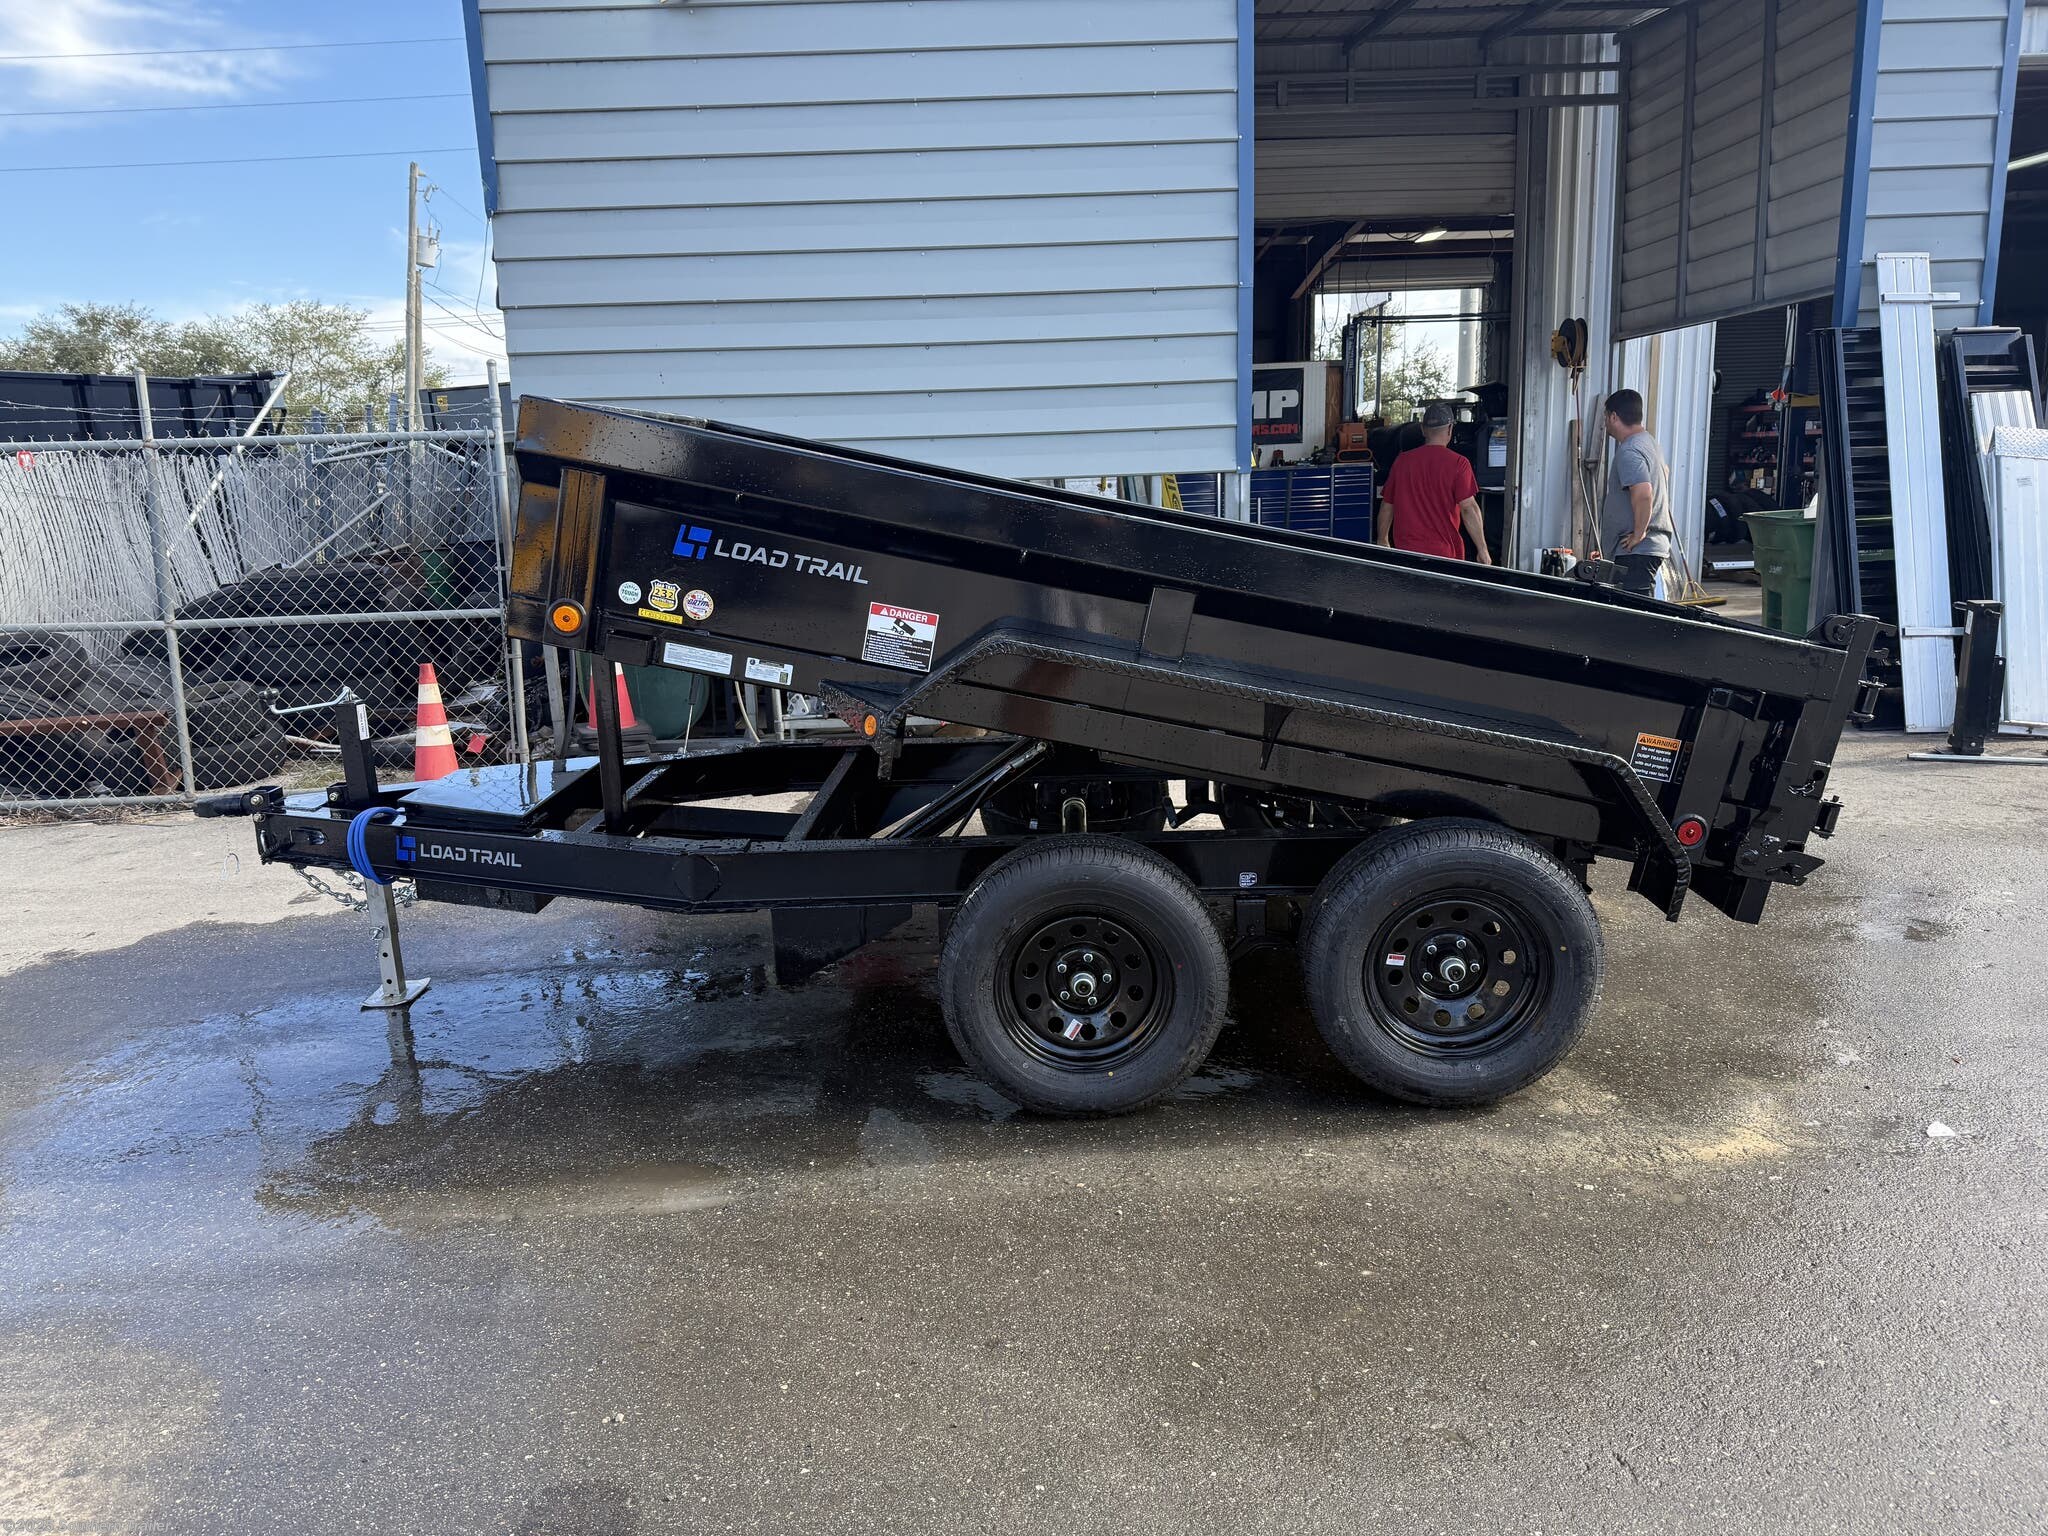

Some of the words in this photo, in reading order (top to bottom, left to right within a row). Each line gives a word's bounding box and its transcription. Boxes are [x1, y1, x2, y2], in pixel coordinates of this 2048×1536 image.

[713, 538, 789, 568] LOAD
[794, 553, 869, 585] TRAIL
[654, 588, 674, 599] 232
[889, 608, 928, 623] DANGER
[1646, 737, 1678, 749] WARNING
[420, 843, 467, 862] LOAD
[469, 848, 522, 868] TRAIL
